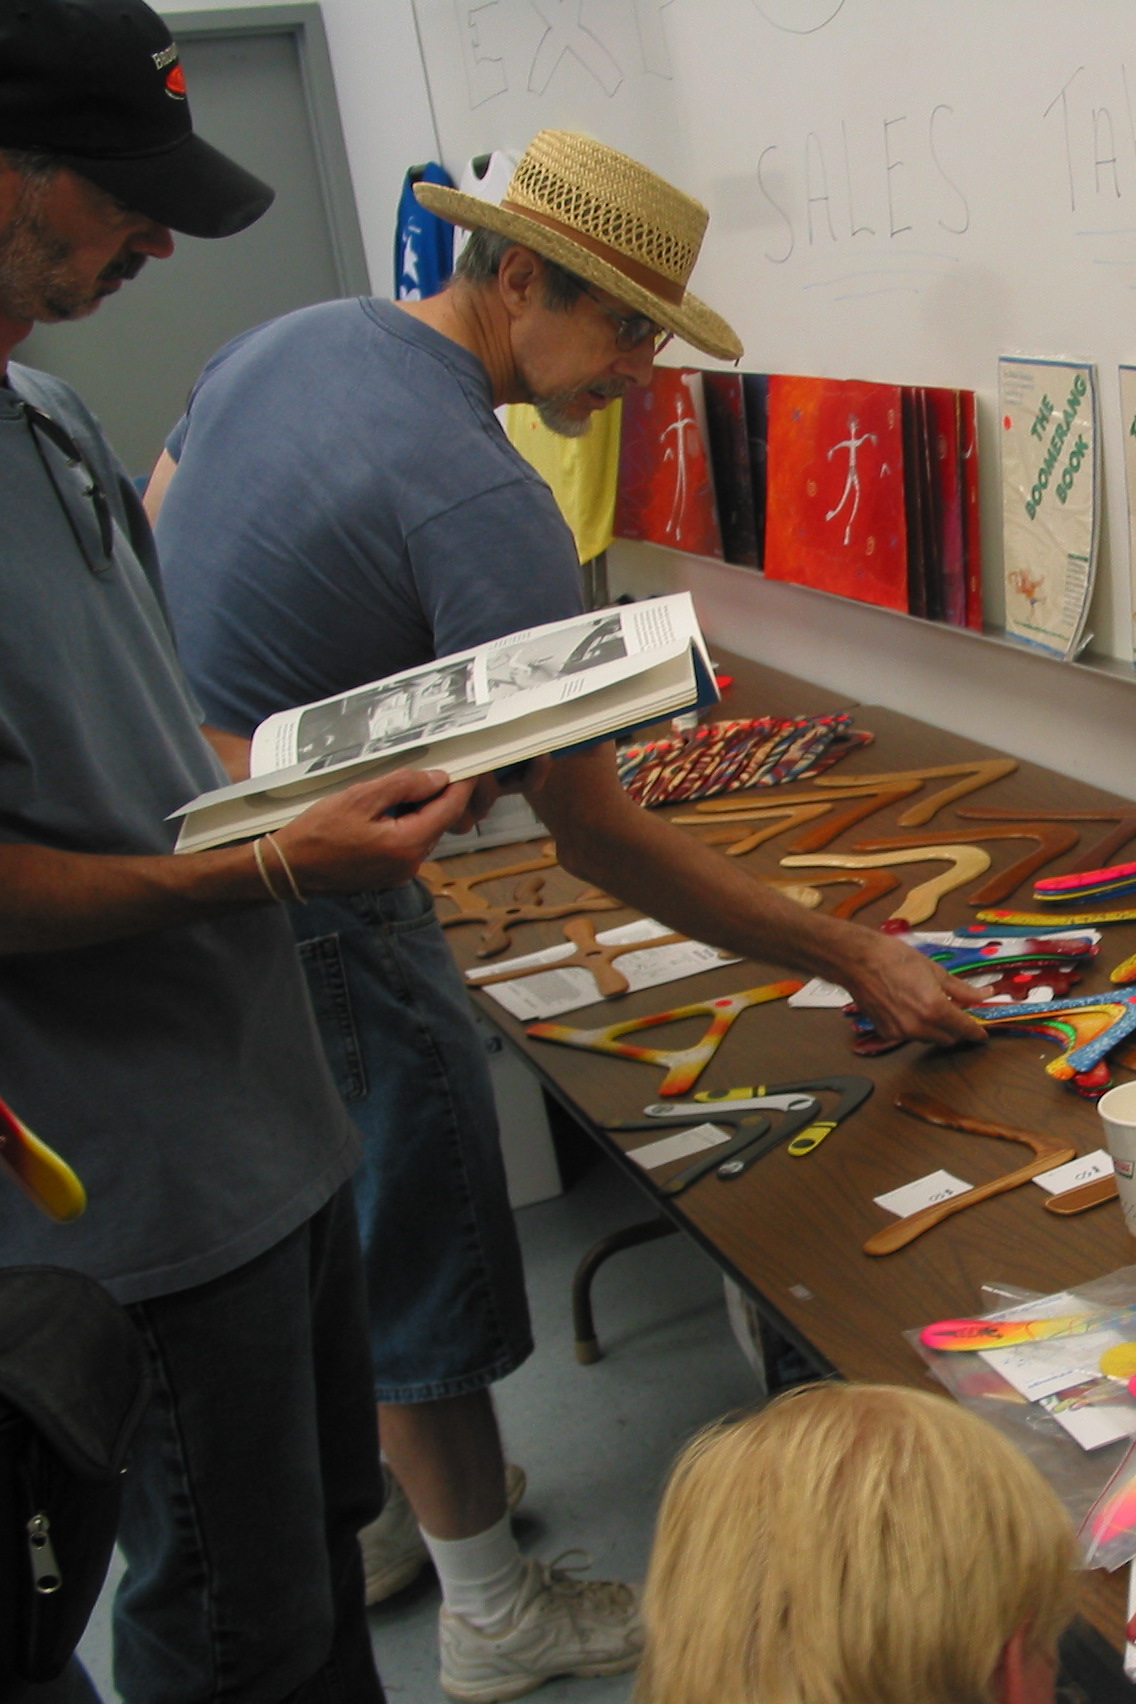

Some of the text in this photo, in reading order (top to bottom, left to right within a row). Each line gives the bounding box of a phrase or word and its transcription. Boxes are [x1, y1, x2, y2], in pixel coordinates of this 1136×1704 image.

[757, 103, 970, 264] SALES
[1025, 374, 1087, 521] BOOMERANG
[1031, 394, 1054, 442] THE
[1056, 433, 1089, 505] BOOK
